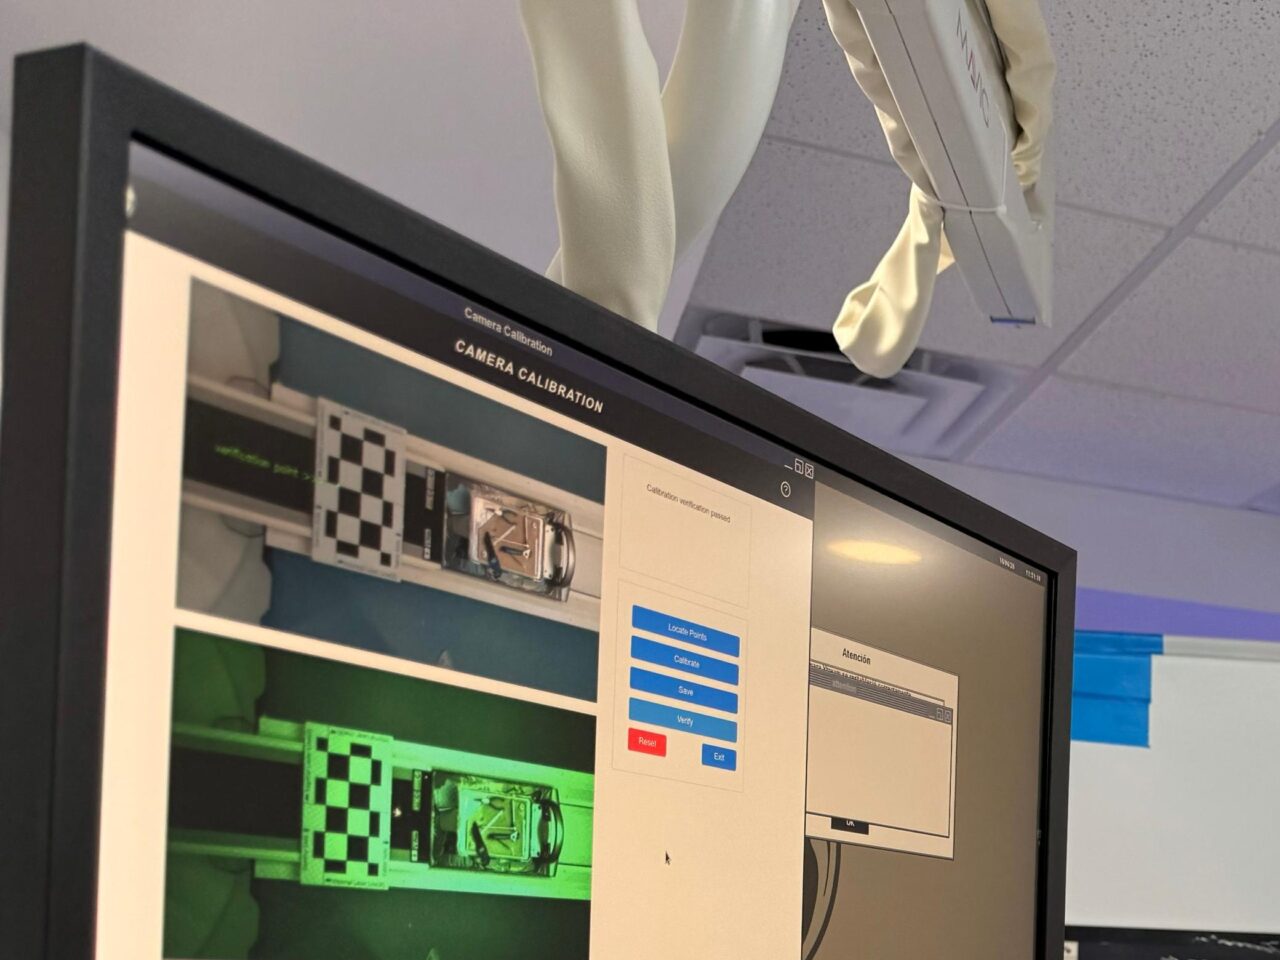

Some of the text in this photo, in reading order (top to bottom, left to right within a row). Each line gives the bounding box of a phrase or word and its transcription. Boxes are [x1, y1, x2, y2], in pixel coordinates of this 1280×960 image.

[464, 306, 553, 357] Camera Calibration
[454, 339, 604, 414] CAMERA CALIBRATION
[646, 483, 731, 523] Calibration verification passed
[668, 623, 708, 642] Locate Points
[673, 654, 700, 669] Calibrate
[842, 647, 871, 666] Atención
[678, 685, 694, 697] Save
[676, 714, 694, 727] Verify
[638, 736, 657, 748] Reset
[713, 752, 725, 762] Exit
